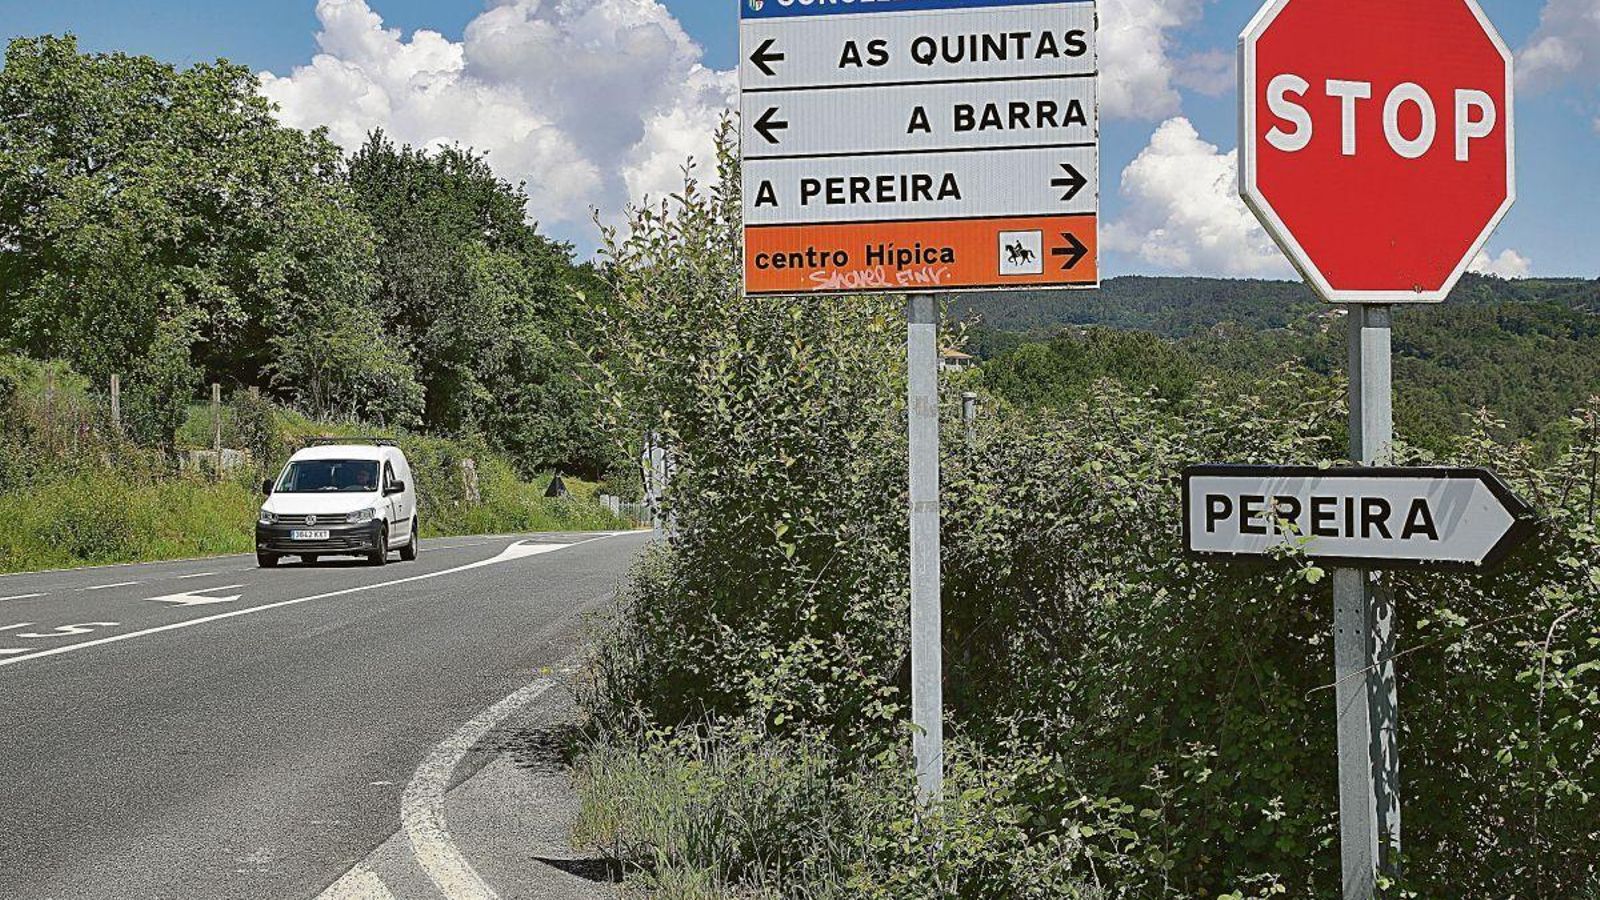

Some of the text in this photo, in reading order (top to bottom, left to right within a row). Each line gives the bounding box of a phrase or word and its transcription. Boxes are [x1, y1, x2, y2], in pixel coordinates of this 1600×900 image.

[839, 30, 1086, 68] AS QUINTAS
[907, 100, 1087, 133] A BARRA
[1265, 74, 1496, 161] STOP
[755, 173, 961, 207] A PEREIRA
[756, 243, 954, 270] centro Hípica
[1207, 495, 1438, 541] PEREIRA
